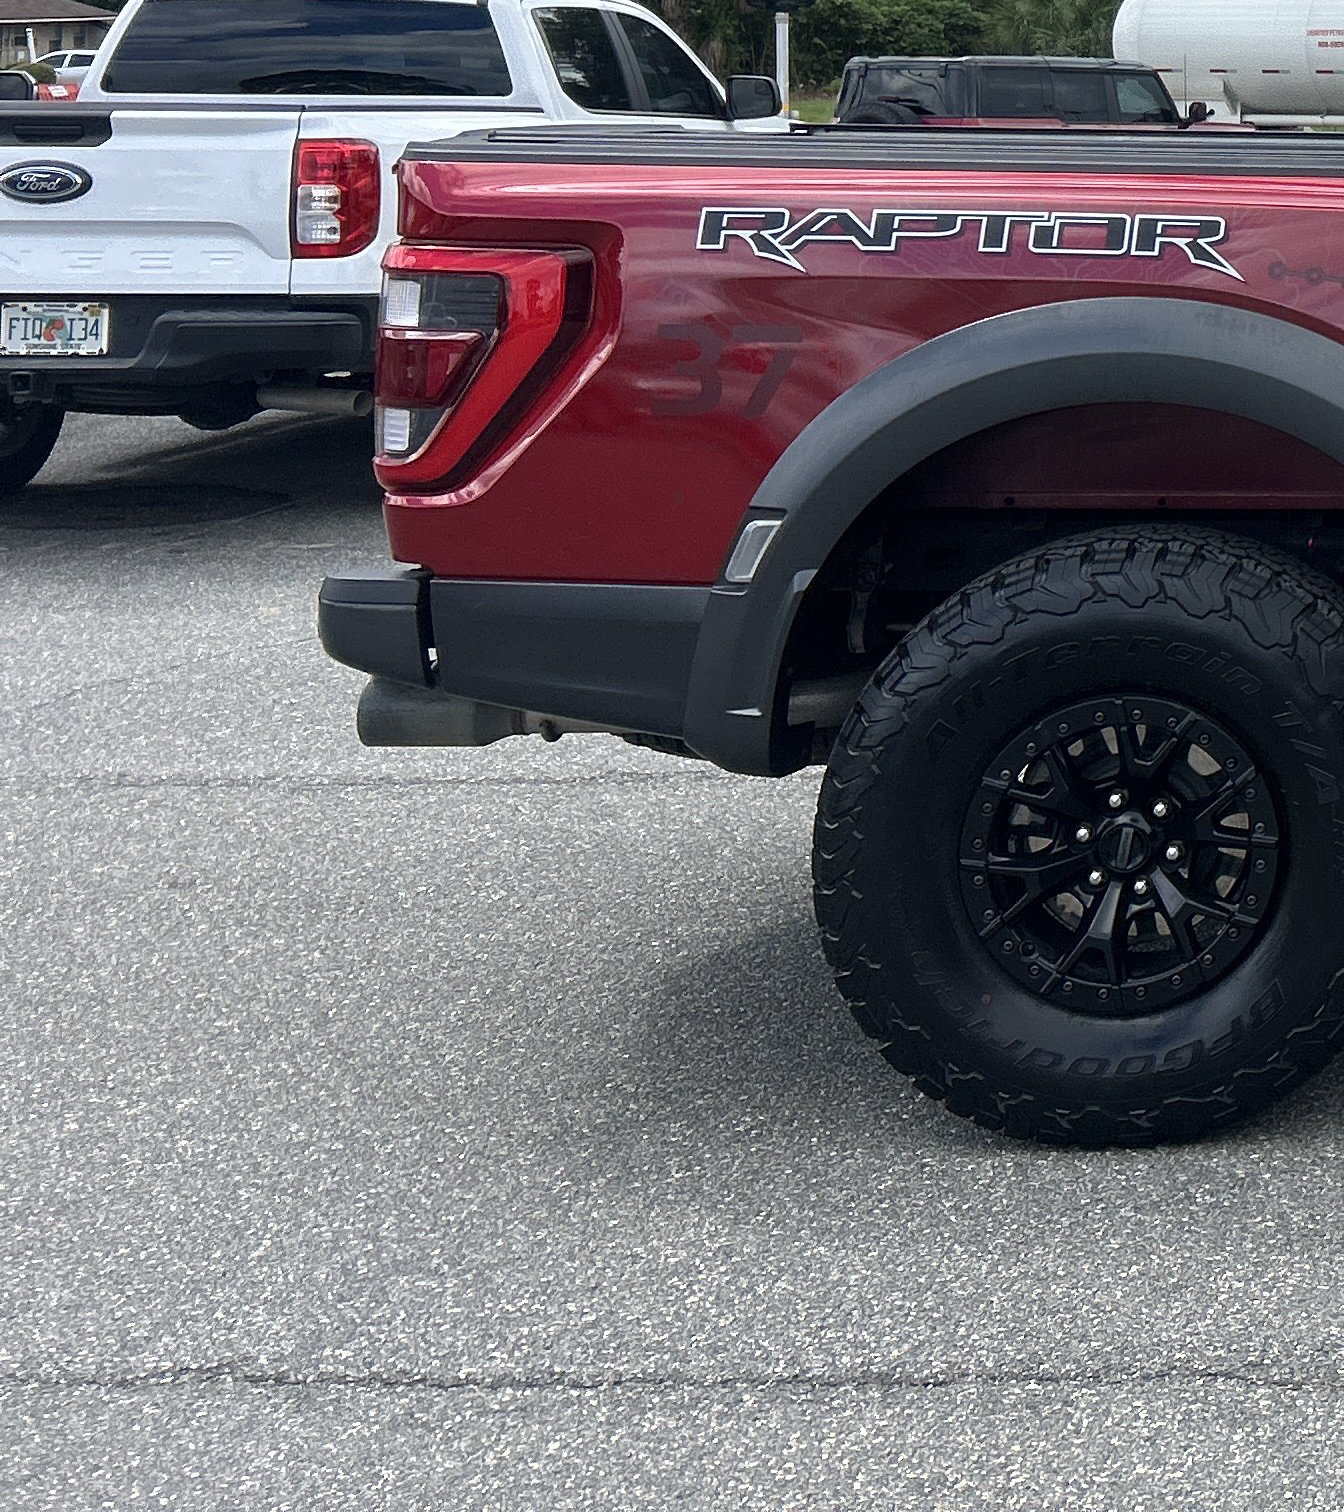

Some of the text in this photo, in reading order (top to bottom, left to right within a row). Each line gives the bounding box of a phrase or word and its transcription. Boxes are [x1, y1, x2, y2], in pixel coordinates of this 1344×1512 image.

[16, 172, 61, 192] Ford
[696, 207, 1246, 282] RAPTOR
[651, 322, 804, 418] 37
[919, 635, 1265, 766] All-Terrain
